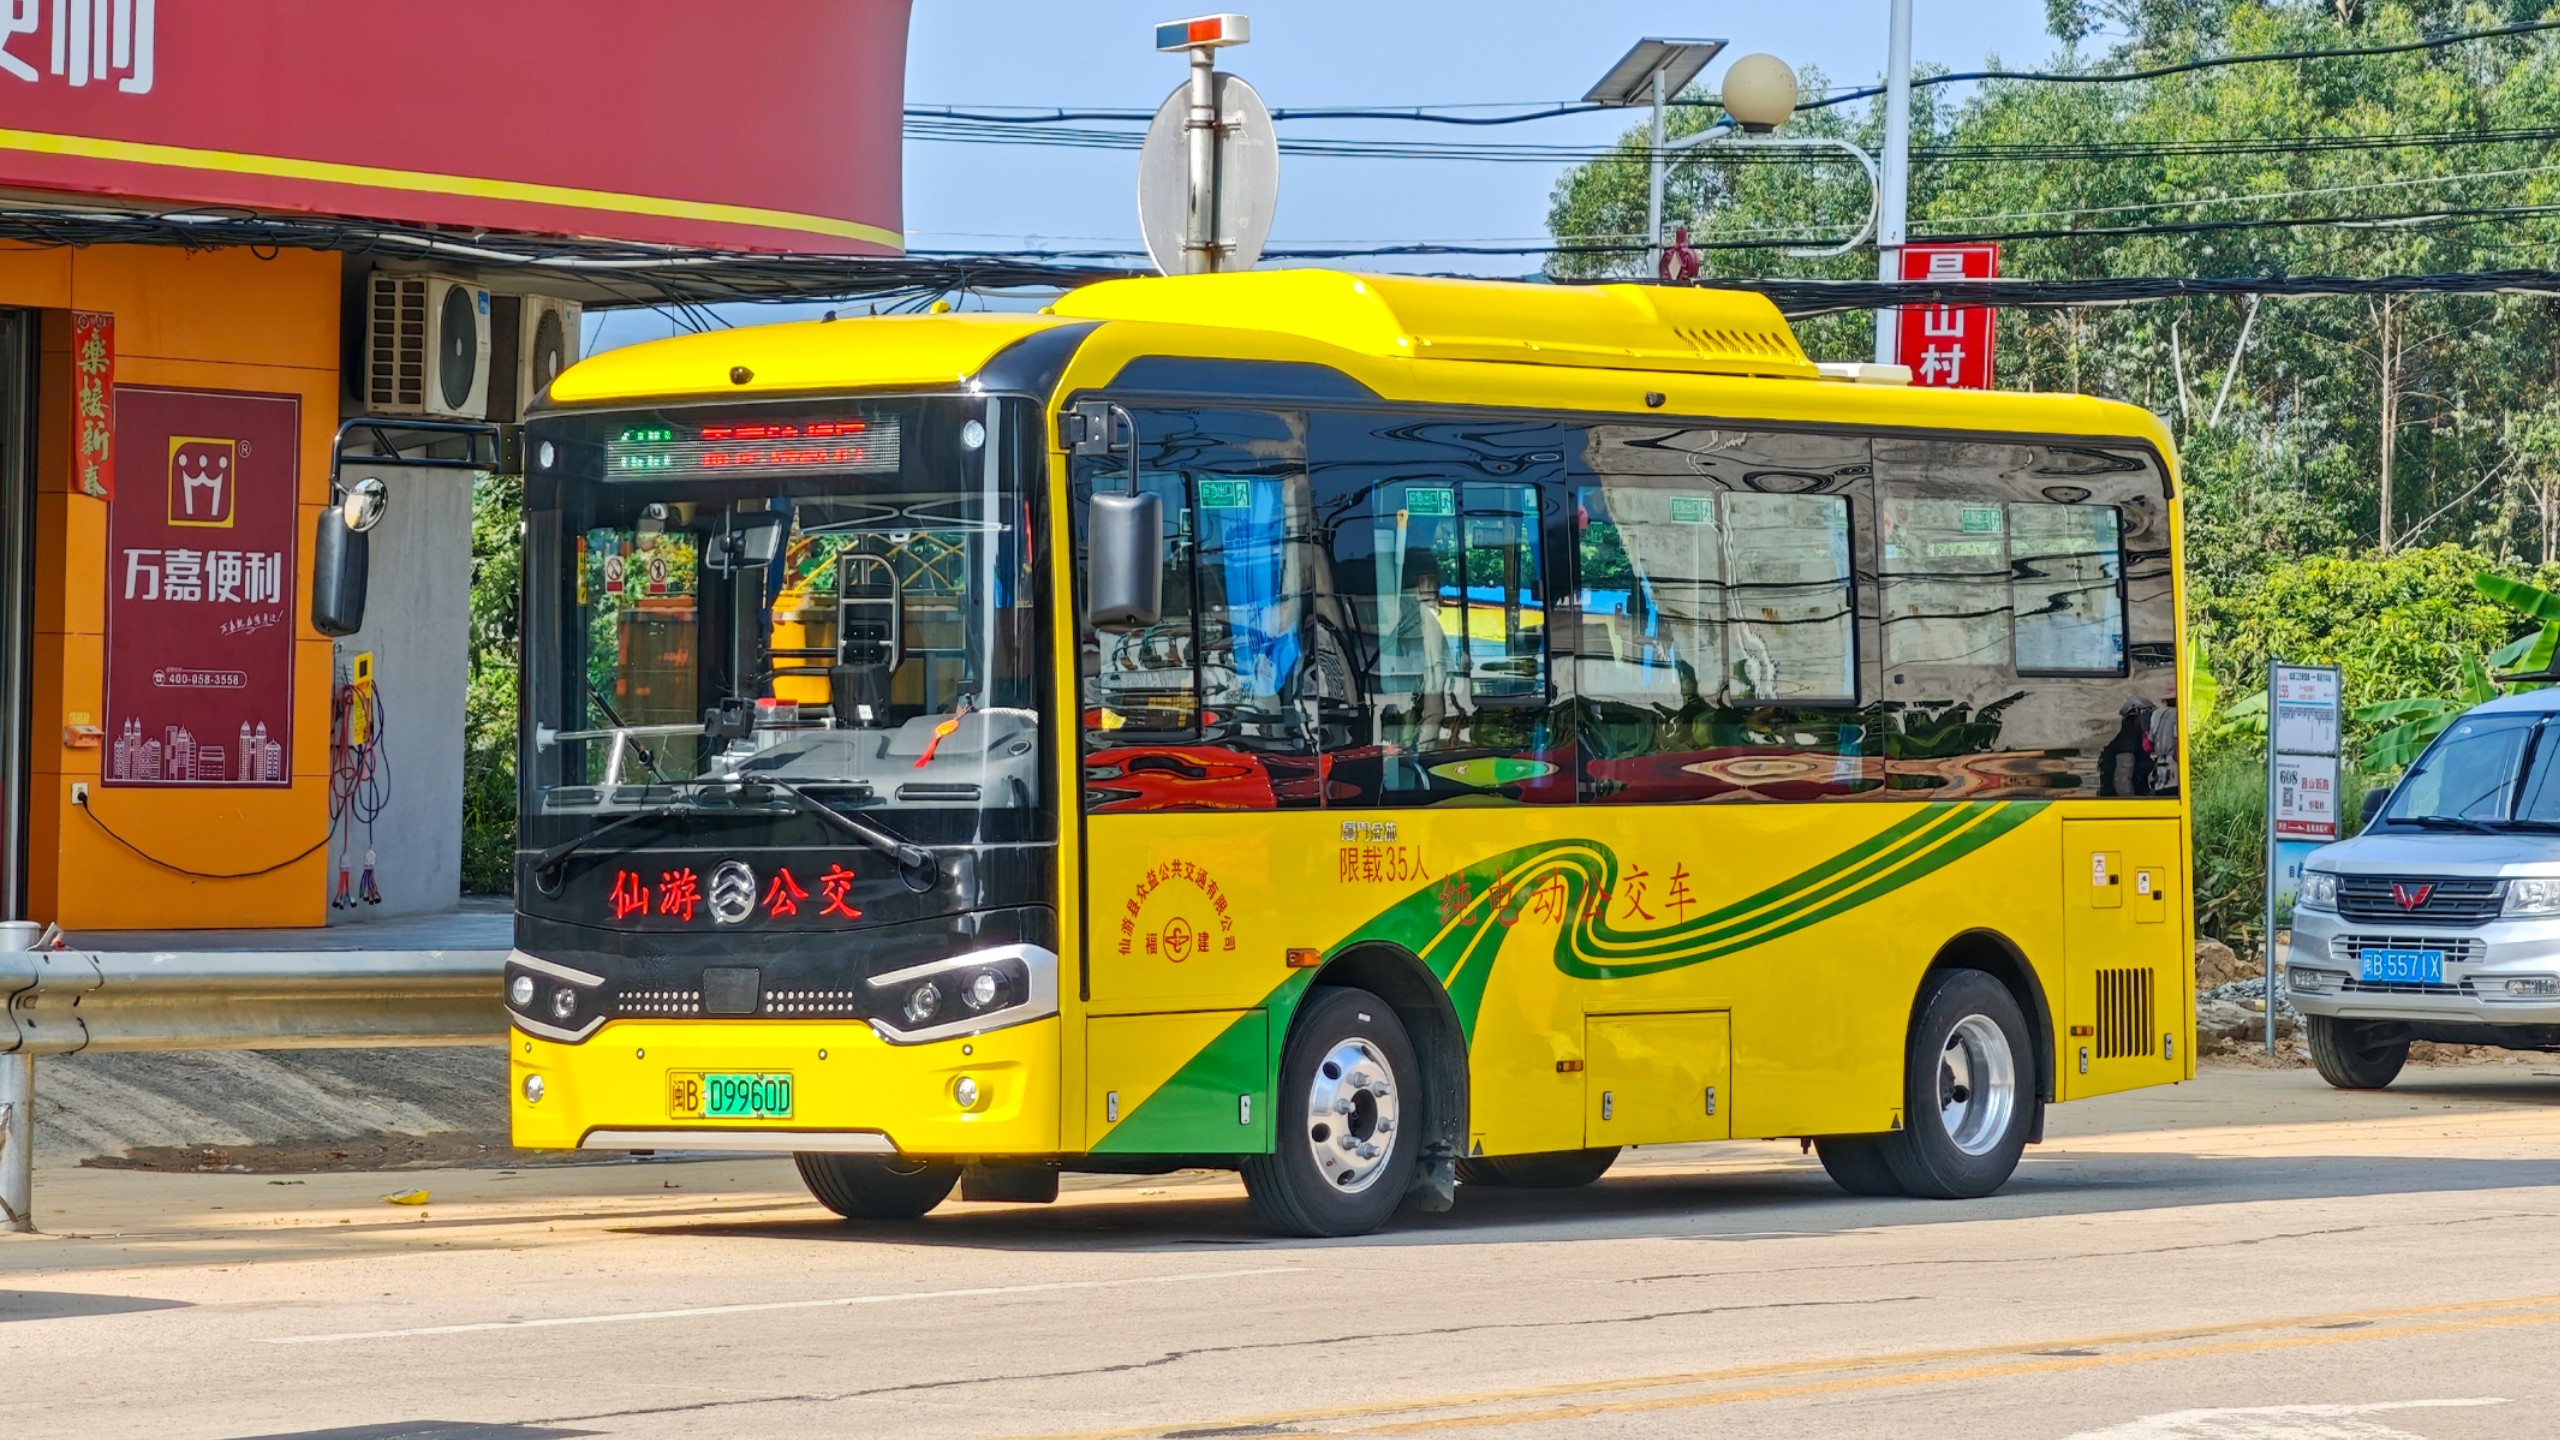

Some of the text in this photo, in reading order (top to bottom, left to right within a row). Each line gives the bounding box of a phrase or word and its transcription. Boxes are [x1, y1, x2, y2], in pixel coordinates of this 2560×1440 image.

[123, 548, 282, 604] 万嘉便利
[169, 673, 239, 686] 400-058-3558
[2280, 770, 2298, 785] 608
[1339, 845, 1430, 884] 限载35人
[1439, 861, 1698, 926] 纯电动公交车
